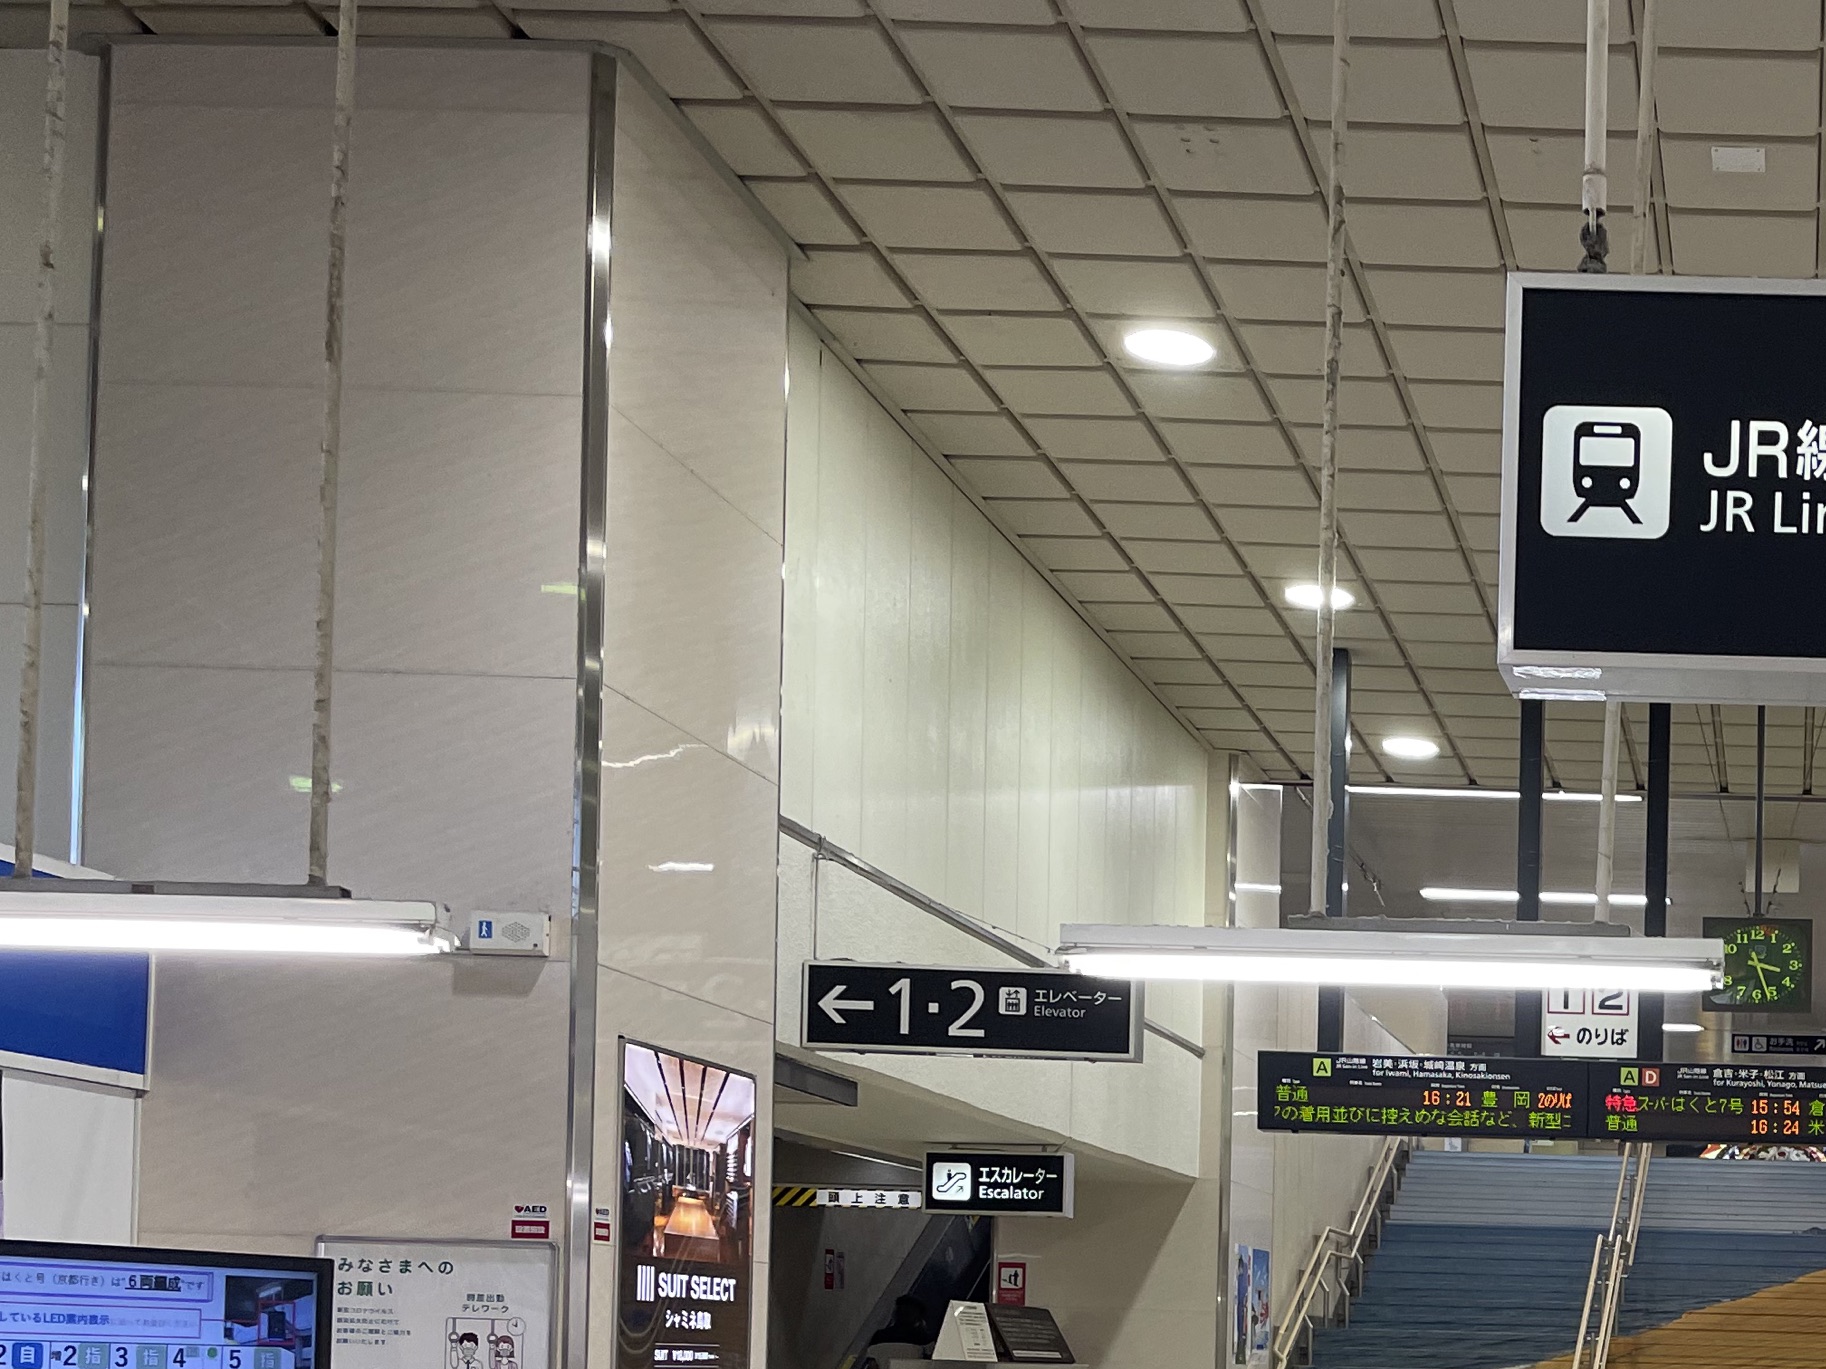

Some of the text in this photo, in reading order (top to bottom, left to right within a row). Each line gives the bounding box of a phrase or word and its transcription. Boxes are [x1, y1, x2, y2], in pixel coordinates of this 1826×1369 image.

[1699, 489, 1755, 534] JR
[1750, 929, 1765, 940] 12
[1782, 943, 1792, 954] 2
[1788, 959, 1799, 971] 3
[1781, 976, 1791, 987] 4
[1033, 988, 1123, 1006] エレベーター
[1736, 985, 1747, 998] 7
[1751, 988, 1762, 1000] 6
[1033, 1005, 1087, 1019] Elevator
[1576, 1027, 1629, 1046] のりば
[1315, 1060, 1329, 1075] A
[1372, 1069, 1384, 1077] for
[1623, 1070, 1657, 1085] A D
[1712, 1079, 1725, 1087] for
[1726, 1080, 1765, 1089] Kurayoshi,
[1767, 1081, 1798, 1090] Yonago,
[1275, 1084, 1309, 1103] 普通
[1604, 1093, 1638, 1112] 特急
[1605, 1114, 1638, 1132] 普通
[978, 1165, 1058, 1184] エスカレーター
[978, 1184, 1045, 1201] Escalator
[524, 1205, 547, 1213] AED
[337, 1257, 454, 1275] みなさまへの
[337, 1280, 394, 1297] お願い
[657, 1271, 737, 1302] SUIT SELECT
[461, 1303, 510, 1314] テレワーク
[20, 1346, 36, 1365] 自
[114, 1346, 129, 1368] 3
[172, 1347, 187, 1369] 4
[228, 1349, 242, 1369] 5
